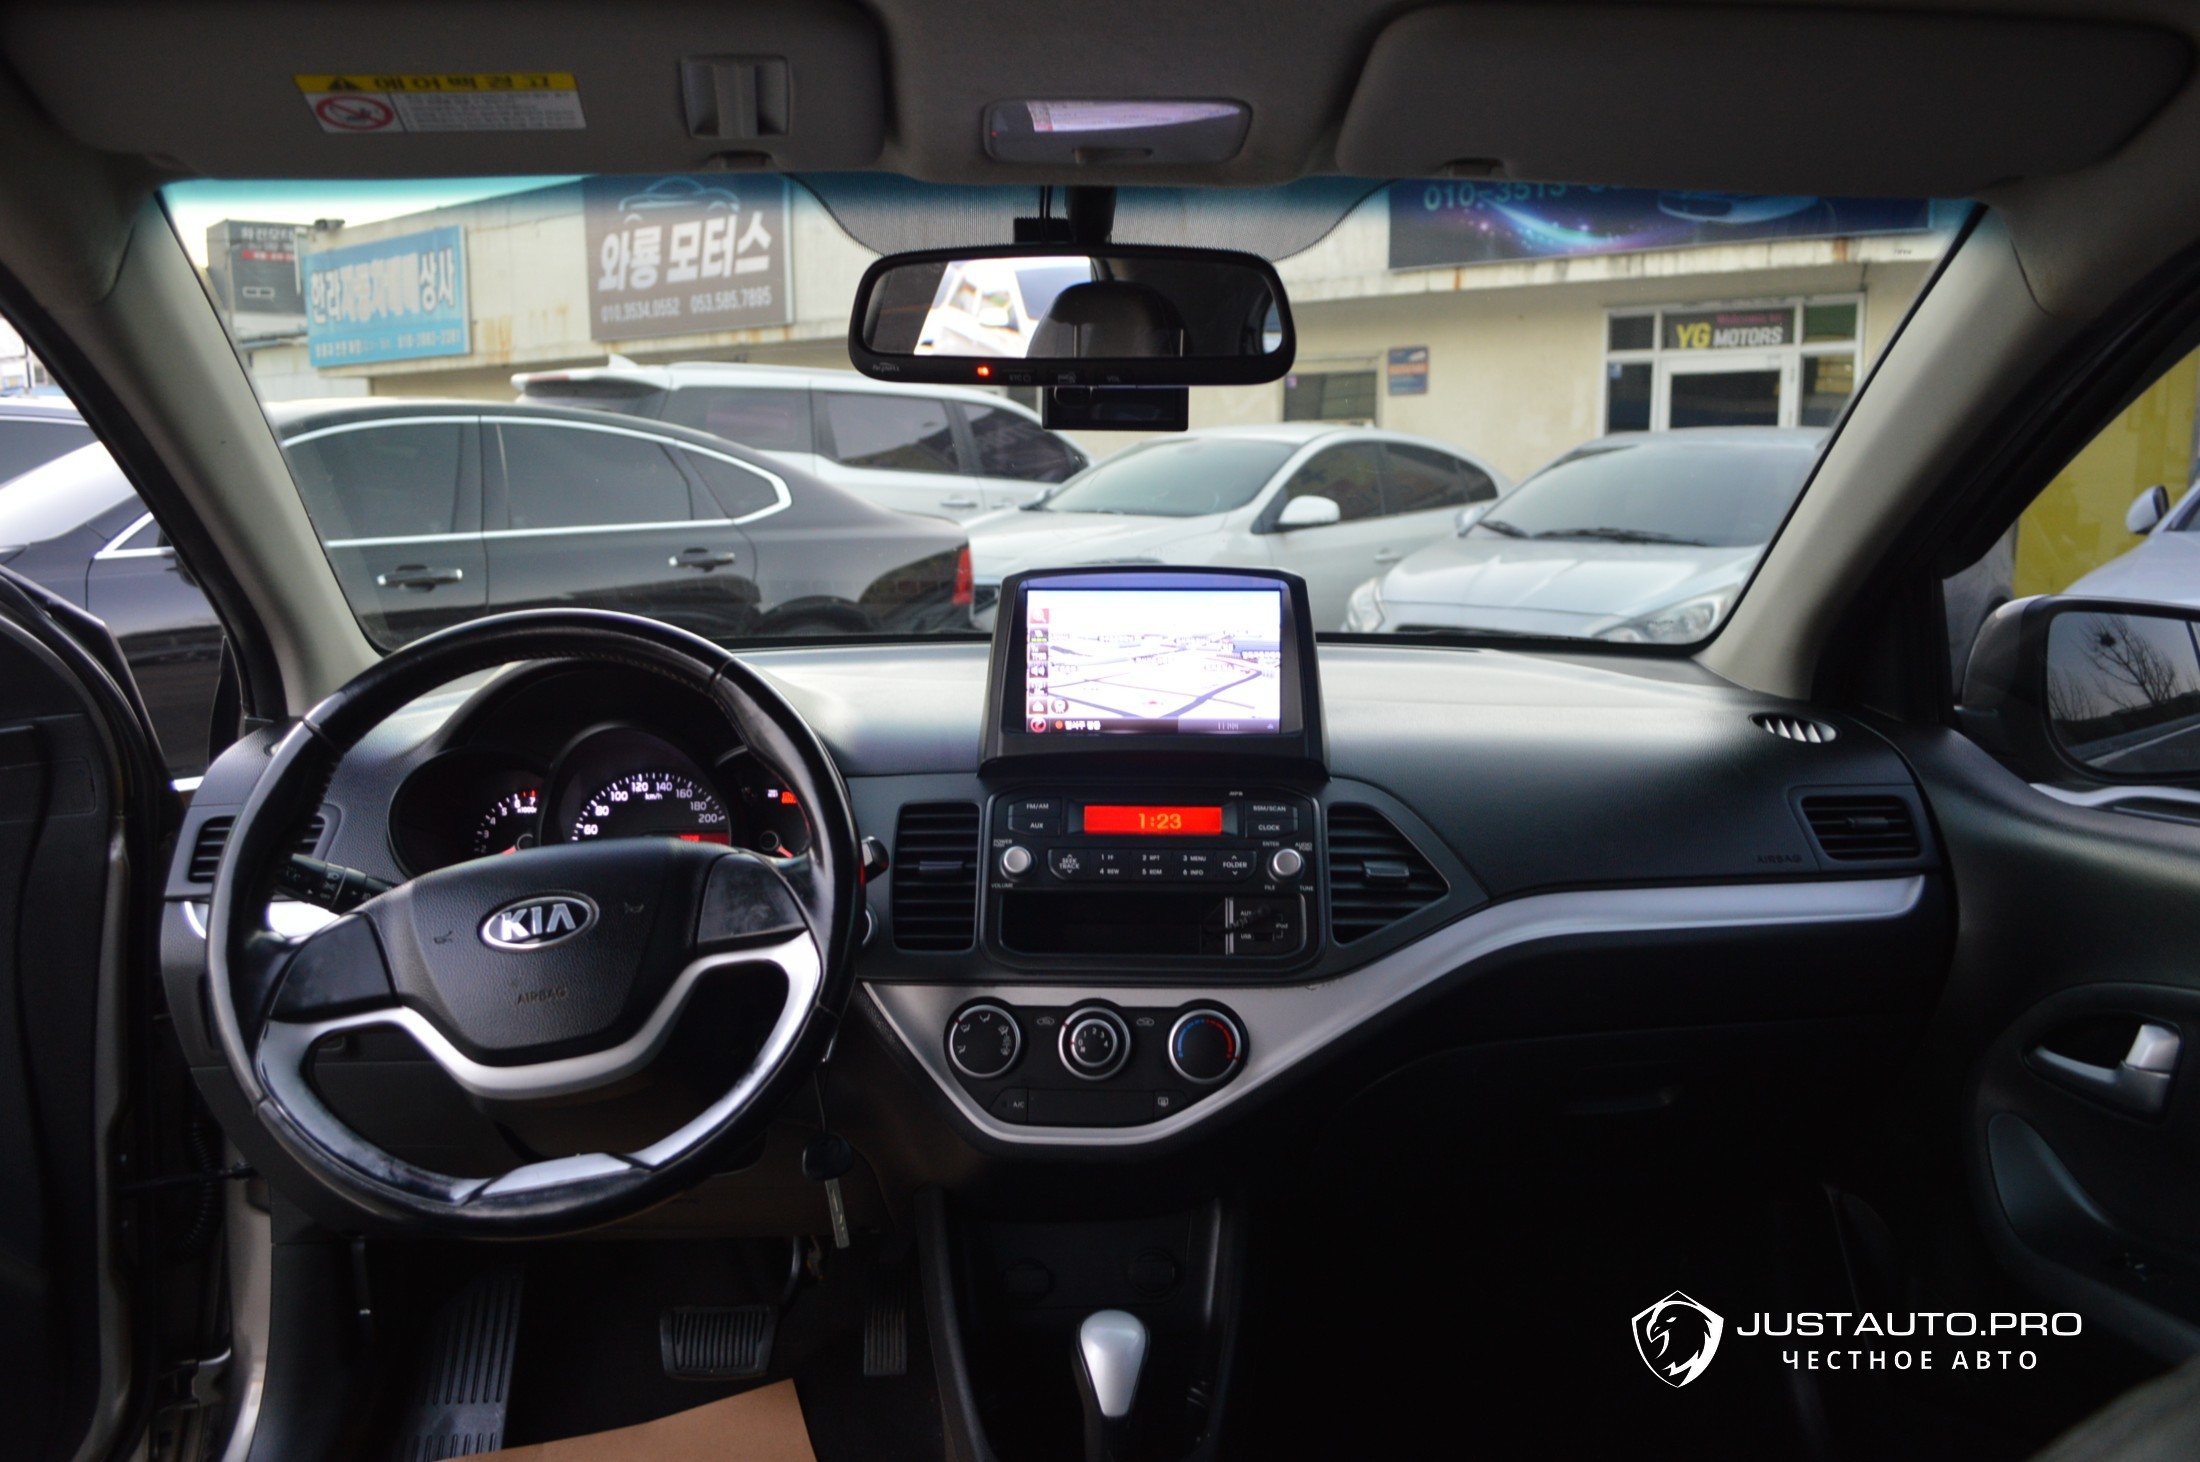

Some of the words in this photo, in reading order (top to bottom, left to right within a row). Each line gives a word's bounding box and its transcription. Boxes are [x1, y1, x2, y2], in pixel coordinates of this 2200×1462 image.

[598, 225, 662, 292] 와룡
[666, 211, 772, 284] 모터스
[1676, 322, 1712, 349] YG
[1713, 326, 1783, 347] MOTORS
[631, 782, 648, 792] 120
[656, 782, 672, 791] 140
[611, 791, 628, 801] 100
[676, 788, 692, 798] 160
[595, 805, 609, 816] 80
[690, 801, 706, 811] 180
[698, 813, 717, 823] 200
[1138, 813, 1182, 830] 1:23
[584, 824, 598, 835] 60
[1142, 854, 1147, 862] 2
[1183, 854, 1188, 862] 3
[1222, 861, 1248, 869] FOLDER
[1099, 867, 1105, 875] 4
[1142, 868, 1147, 876] 5
[1149, 868, 1163, 876] RDM
[1182, 868, 1188, 876] 6
[501, 903, 577, 941] KIA
[1013, 1101, 1025, 1109] A/C
